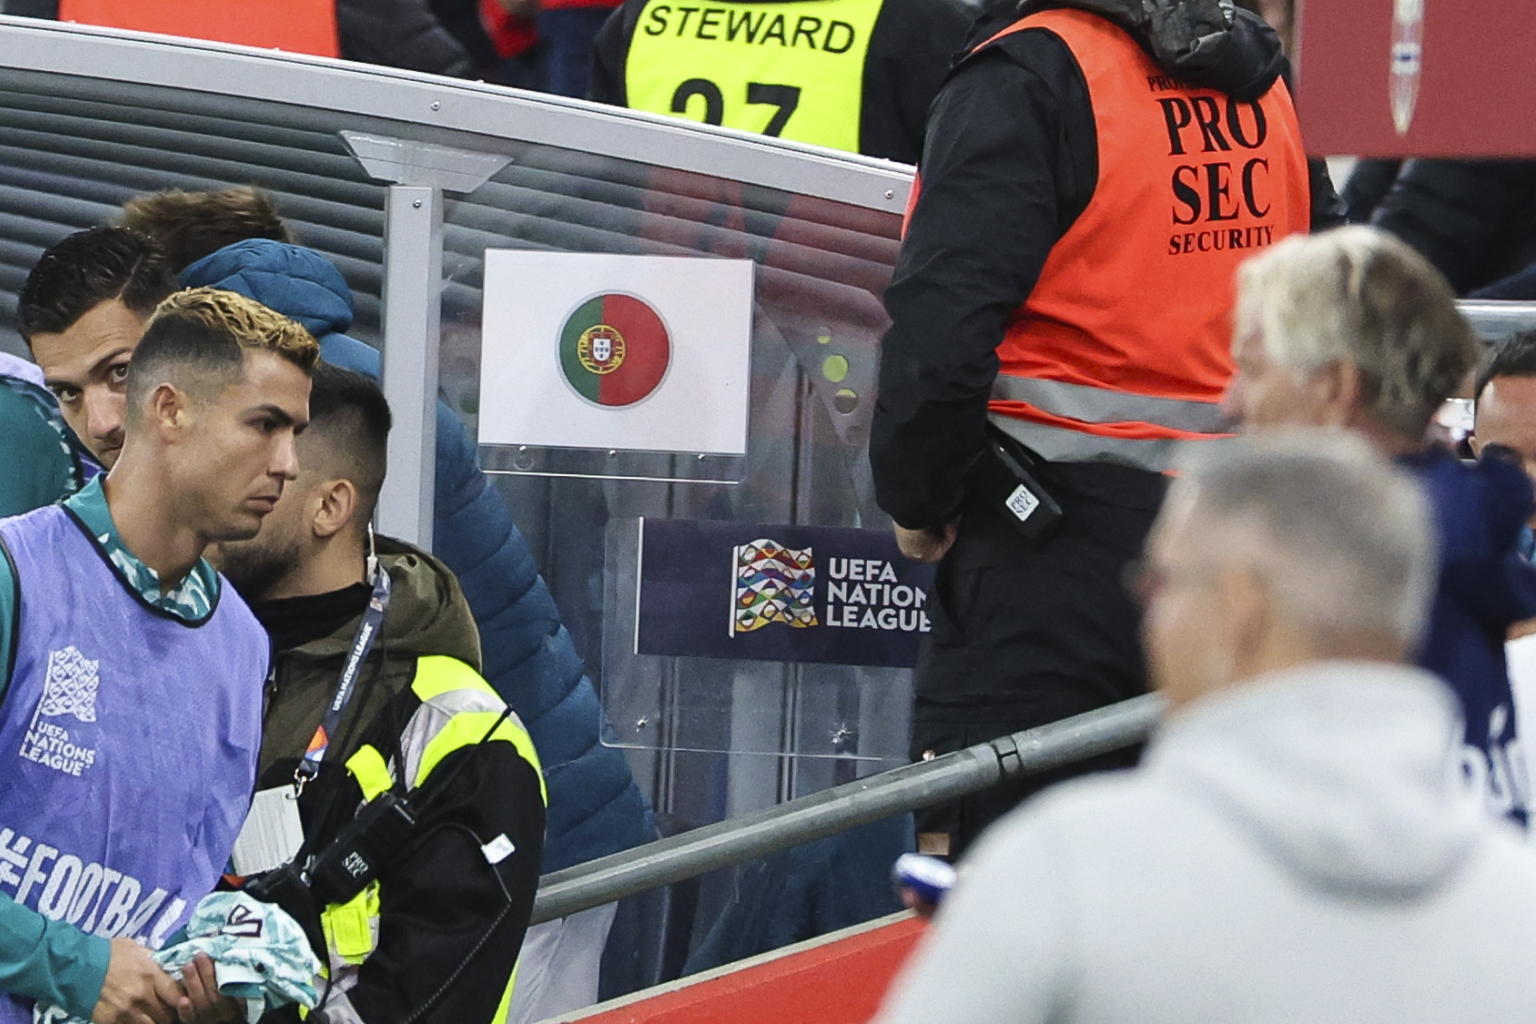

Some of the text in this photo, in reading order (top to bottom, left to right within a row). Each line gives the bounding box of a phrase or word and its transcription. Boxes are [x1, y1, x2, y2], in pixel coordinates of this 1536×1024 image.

[644, 5, 855, 54] STEWARD
[1155, 95, 1267, 156] PRO
[1171, 158, 1271, 225] SEC
[1168, 225, 1275, 255] SECURITY
[829, 557, 898, 582] UEFA
[340, 654, 360, 692] NATIONS
[353, 622, 374, 657] LEAGUE
[24, 730, 96, 765] NATIONS
[37, 720, 69, 742] UEFA
[19, 743, 85, 777] LEAGUE
